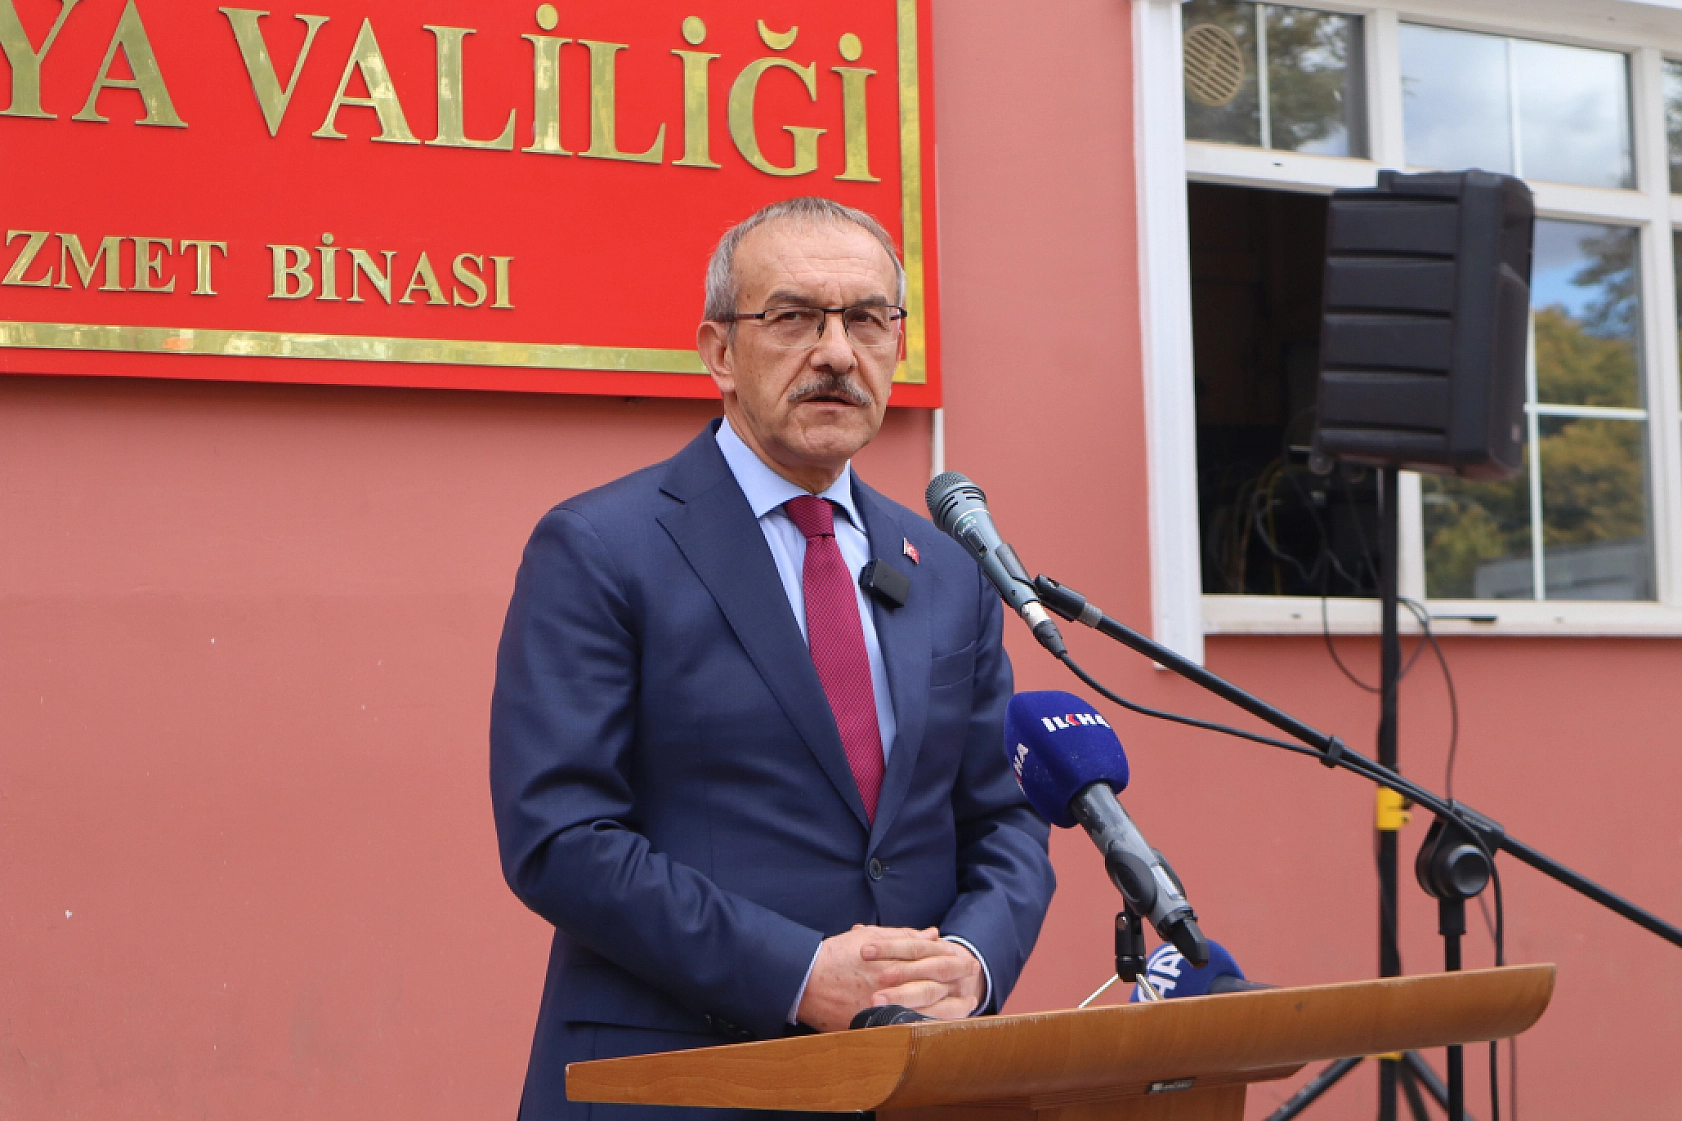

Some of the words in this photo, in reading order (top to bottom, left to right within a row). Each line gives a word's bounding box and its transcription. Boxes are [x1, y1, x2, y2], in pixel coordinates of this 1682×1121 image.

[219, 3, 881, 182] VALİLİĞİ
[1, 229, 228, 295] ZMET
[266, 233, 514, 309] BİNASI
